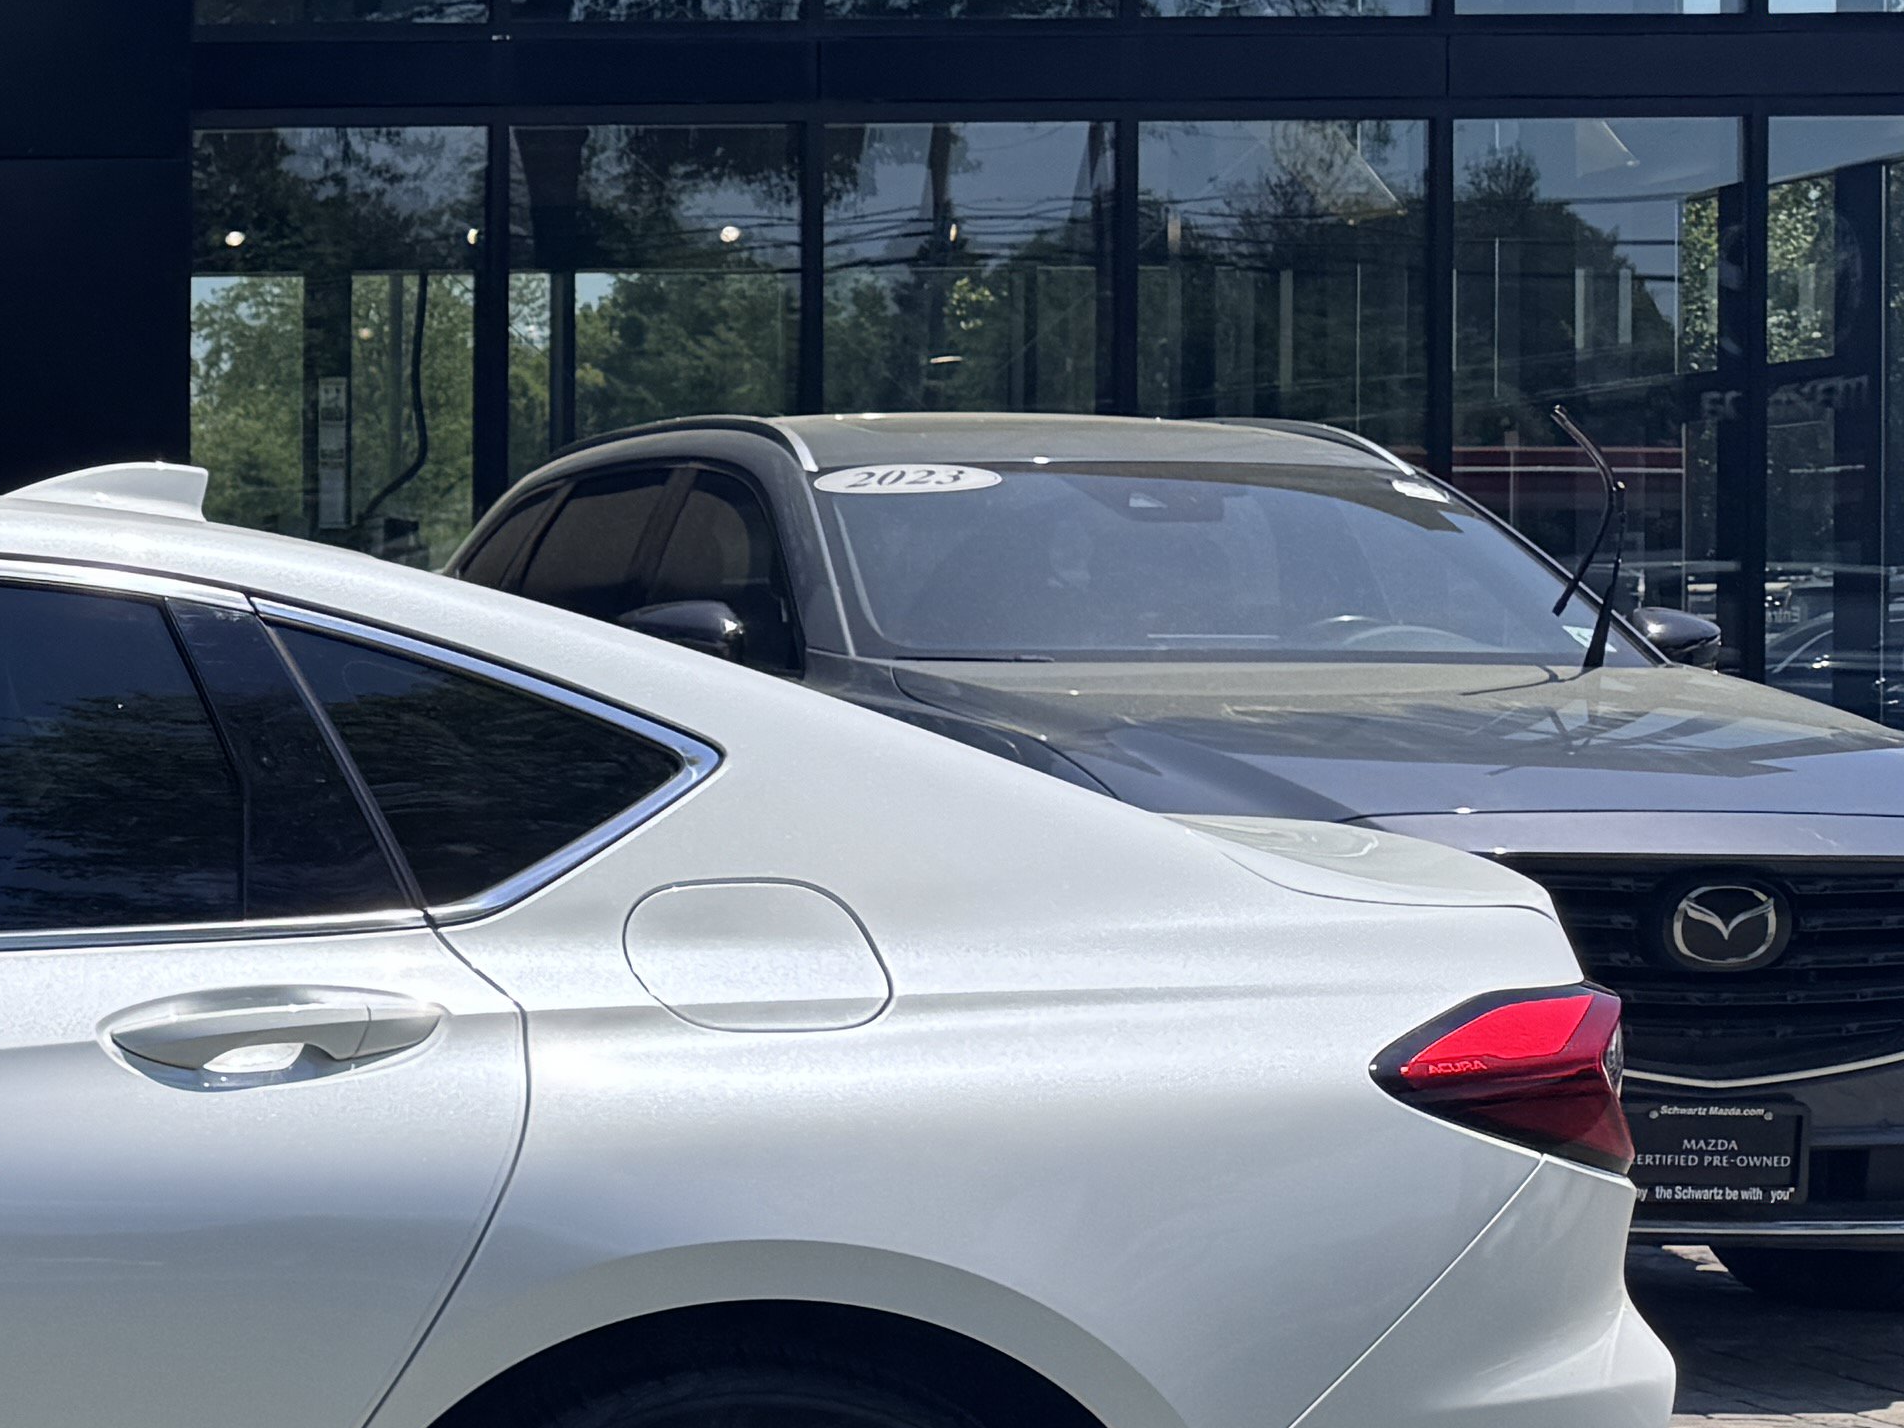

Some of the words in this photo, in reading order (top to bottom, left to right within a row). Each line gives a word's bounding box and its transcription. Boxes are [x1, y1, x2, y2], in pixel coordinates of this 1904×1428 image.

[845, 469, 965, 489] 2023
[1428, 1059, 1488, 1075] ACURA
[1660, 1104, 1707, 1116] Schwartz
[1682, 1139, 1739, 1151] MAZDA
[1634, 1154, 1699, 1166] ERTIFIED
[1703, 1155, 1792, 1168] PRE-OWNED
[1655, 1185, 1672, 1200] the
[1674, 1185, 1724, 1201] Schwartz
[1725, 1186, 1739, 1201] be
[1740, 1187, 1763, 1201] with
